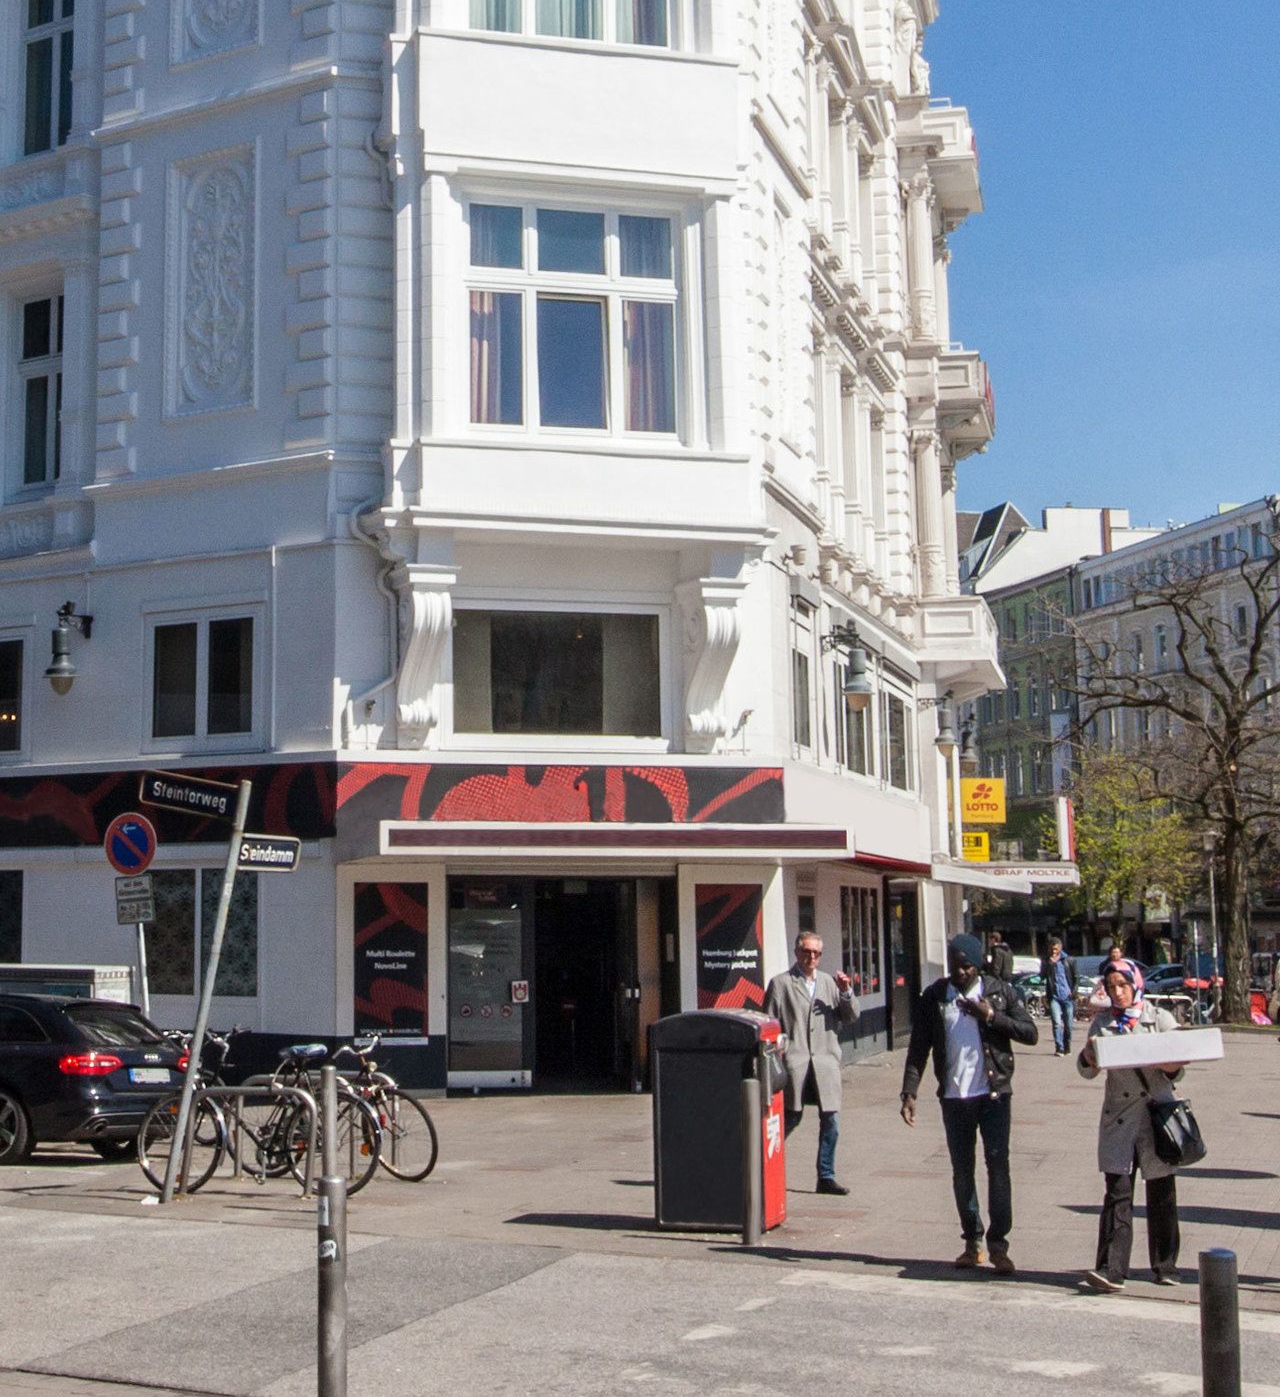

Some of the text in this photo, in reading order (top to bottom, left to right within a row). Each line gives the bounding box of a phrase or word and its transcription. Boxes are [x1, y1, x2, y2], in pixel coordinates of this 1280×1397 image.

[152, 781, 227, 814] Steintorweg
[966, 803, 998, 811] LOTTO
[240, 844, 295, 864] Seindamm
[702, 949, 732, 958] Hamburg
[704, 961, 730, 970] Mystery
